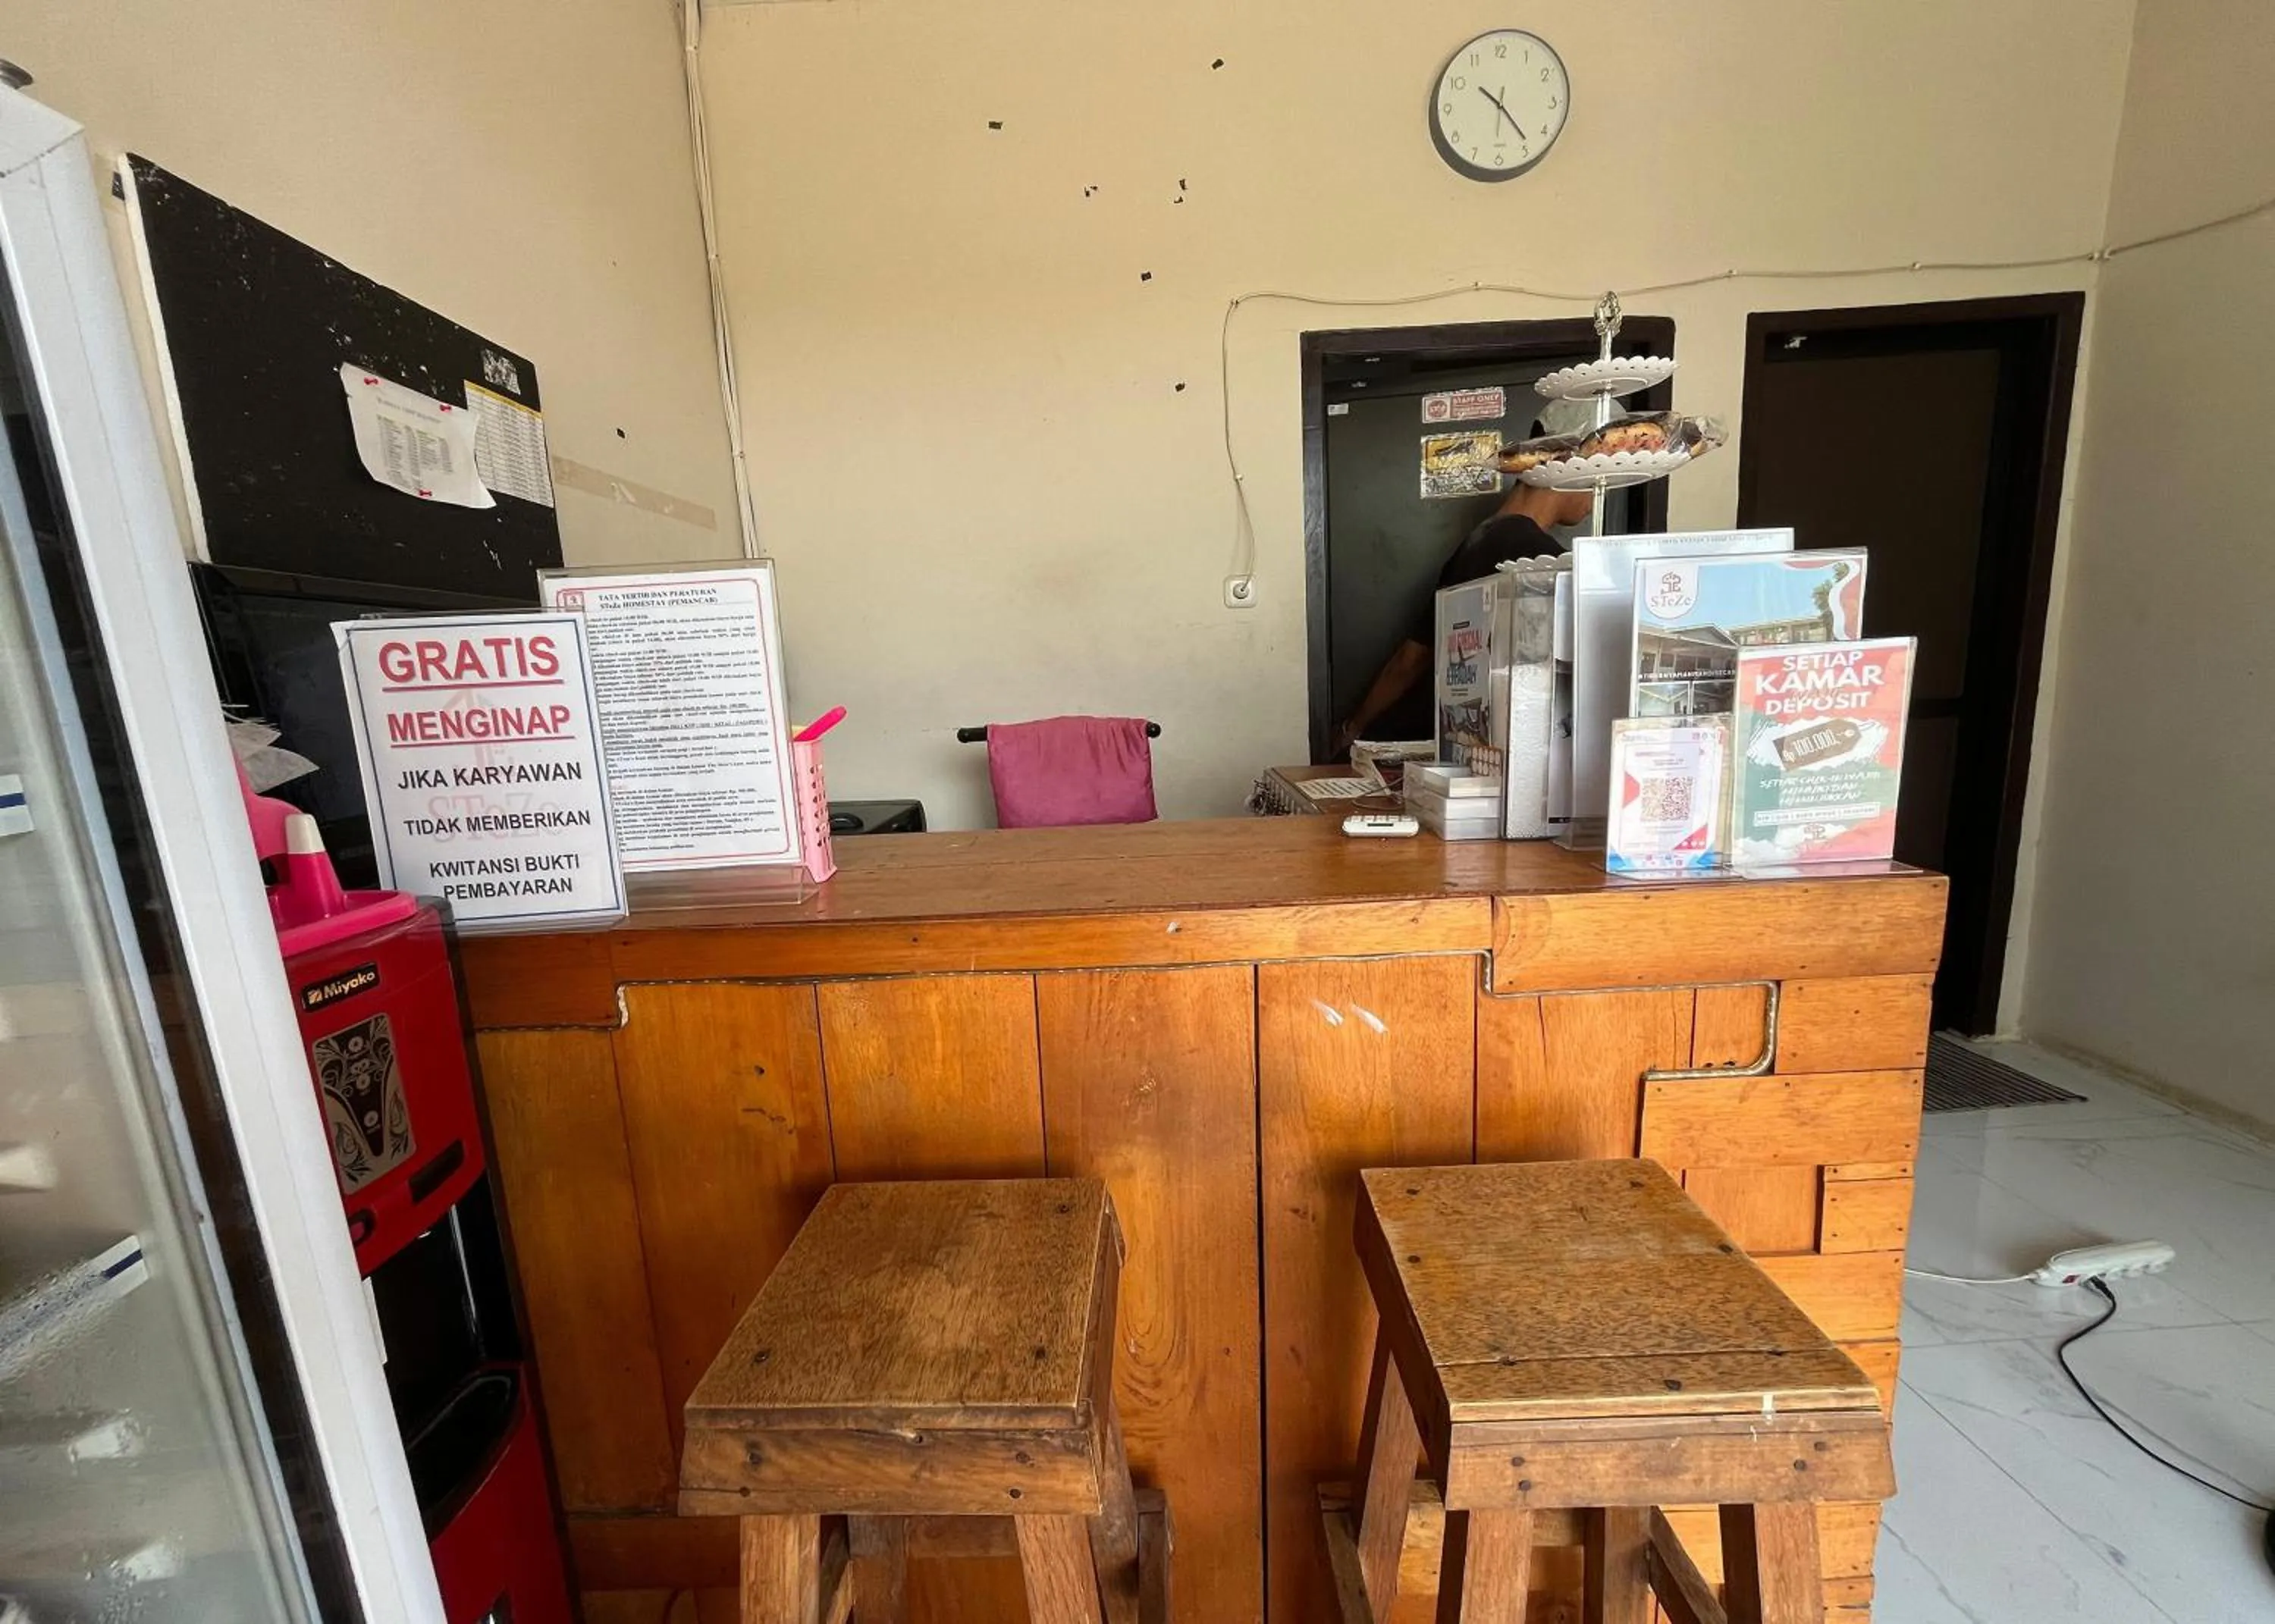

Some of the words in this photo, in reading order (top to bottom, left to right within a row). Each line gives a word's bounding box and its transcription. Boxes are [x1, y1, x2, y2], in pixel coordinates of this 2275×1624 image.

[1495, 45, 1508, 58] 12
[1524, 51, 1529, 63] 1
[1470, 54, 1480, 67] 11
[1540, 68, 1549, 82] 2
[1451, 77, 1466, 90] 10
[1443, 103, 1452, 116] 9
[1548, 97, 1557, 109] 3
[1451, 130, 1460, 143] 8
[1540, 124, 1548, 135] 4
[1472, 147, 1478, 161] 7
[1494, 152, 1504, 166] 6
[1521, 146, 1530, 158] 5
[623, 599, 666, 607] HOMESTAY
[378, 636, 560, 683] GRATIS
[1782, 651, 1865, 671] SETIAP
[1756, 665, 1884, 695] KAMAR
[1765, 691, 1872, 716] DEPOSIT
[388, 704, 570, 742] MENGINAP
[397, 767, 447, 789] JIKA
[453, 761, 582, 787] KARYAWAN
[403, 817, 461, 836] TIDAK
[466, 810, 592, 832] MEMBERIKAN
[429, 857, 520, 878] KWITANSI
[526, 853, 580, 873] BUKTI
[444, 877, 573, 900] PEMBAYARAN
[323, 971, 375, 999] Miyako
